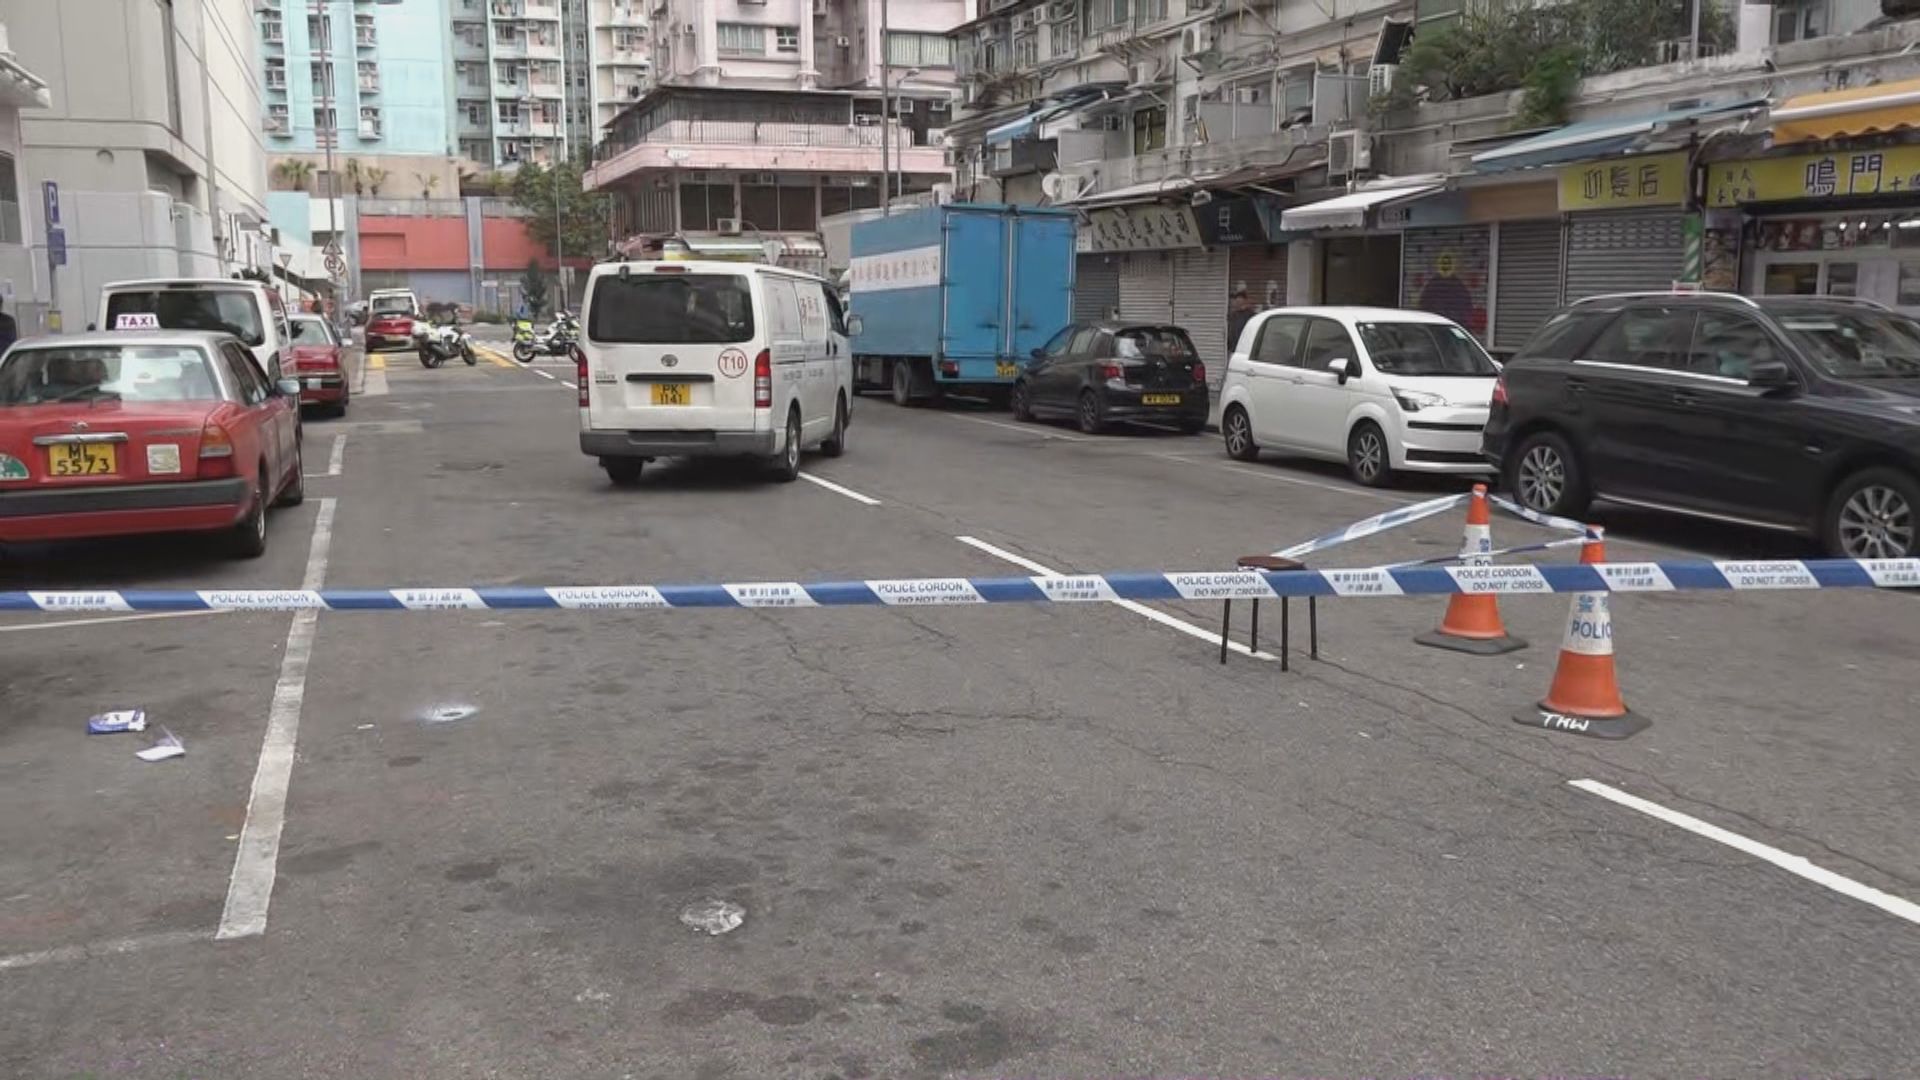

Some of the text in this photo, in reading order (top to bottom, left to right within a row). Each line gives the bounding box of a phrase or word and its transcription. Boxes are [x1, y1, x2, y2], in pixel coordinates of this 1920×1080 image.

[1804, 154, 1884, 197] 鳴門
[120, 316, 154, 326] TAXI
[721, 355, 745, 370] T10
[56, 457, 110, 474] 5573
[1724, 563, 1756, 573] POLICE
[1457, 569, 1491, 579] POLICE
[1176, 575, 1212, 585] POLICE
[1741, 576, 1755, 585] DO
[1756, 575, 1775, 585] NOT
[878, 582, 917, 593] POLICE
[1473, 582, 1487, 591] DO
[1487, 581, 1507, 590] NOT
[558, 589, 597, 600] POLICE
[1194, 588, 1209, 597] DO
[1210, 588, 1231, 596] NOT
[210, 593, 254, 604] POLICE
